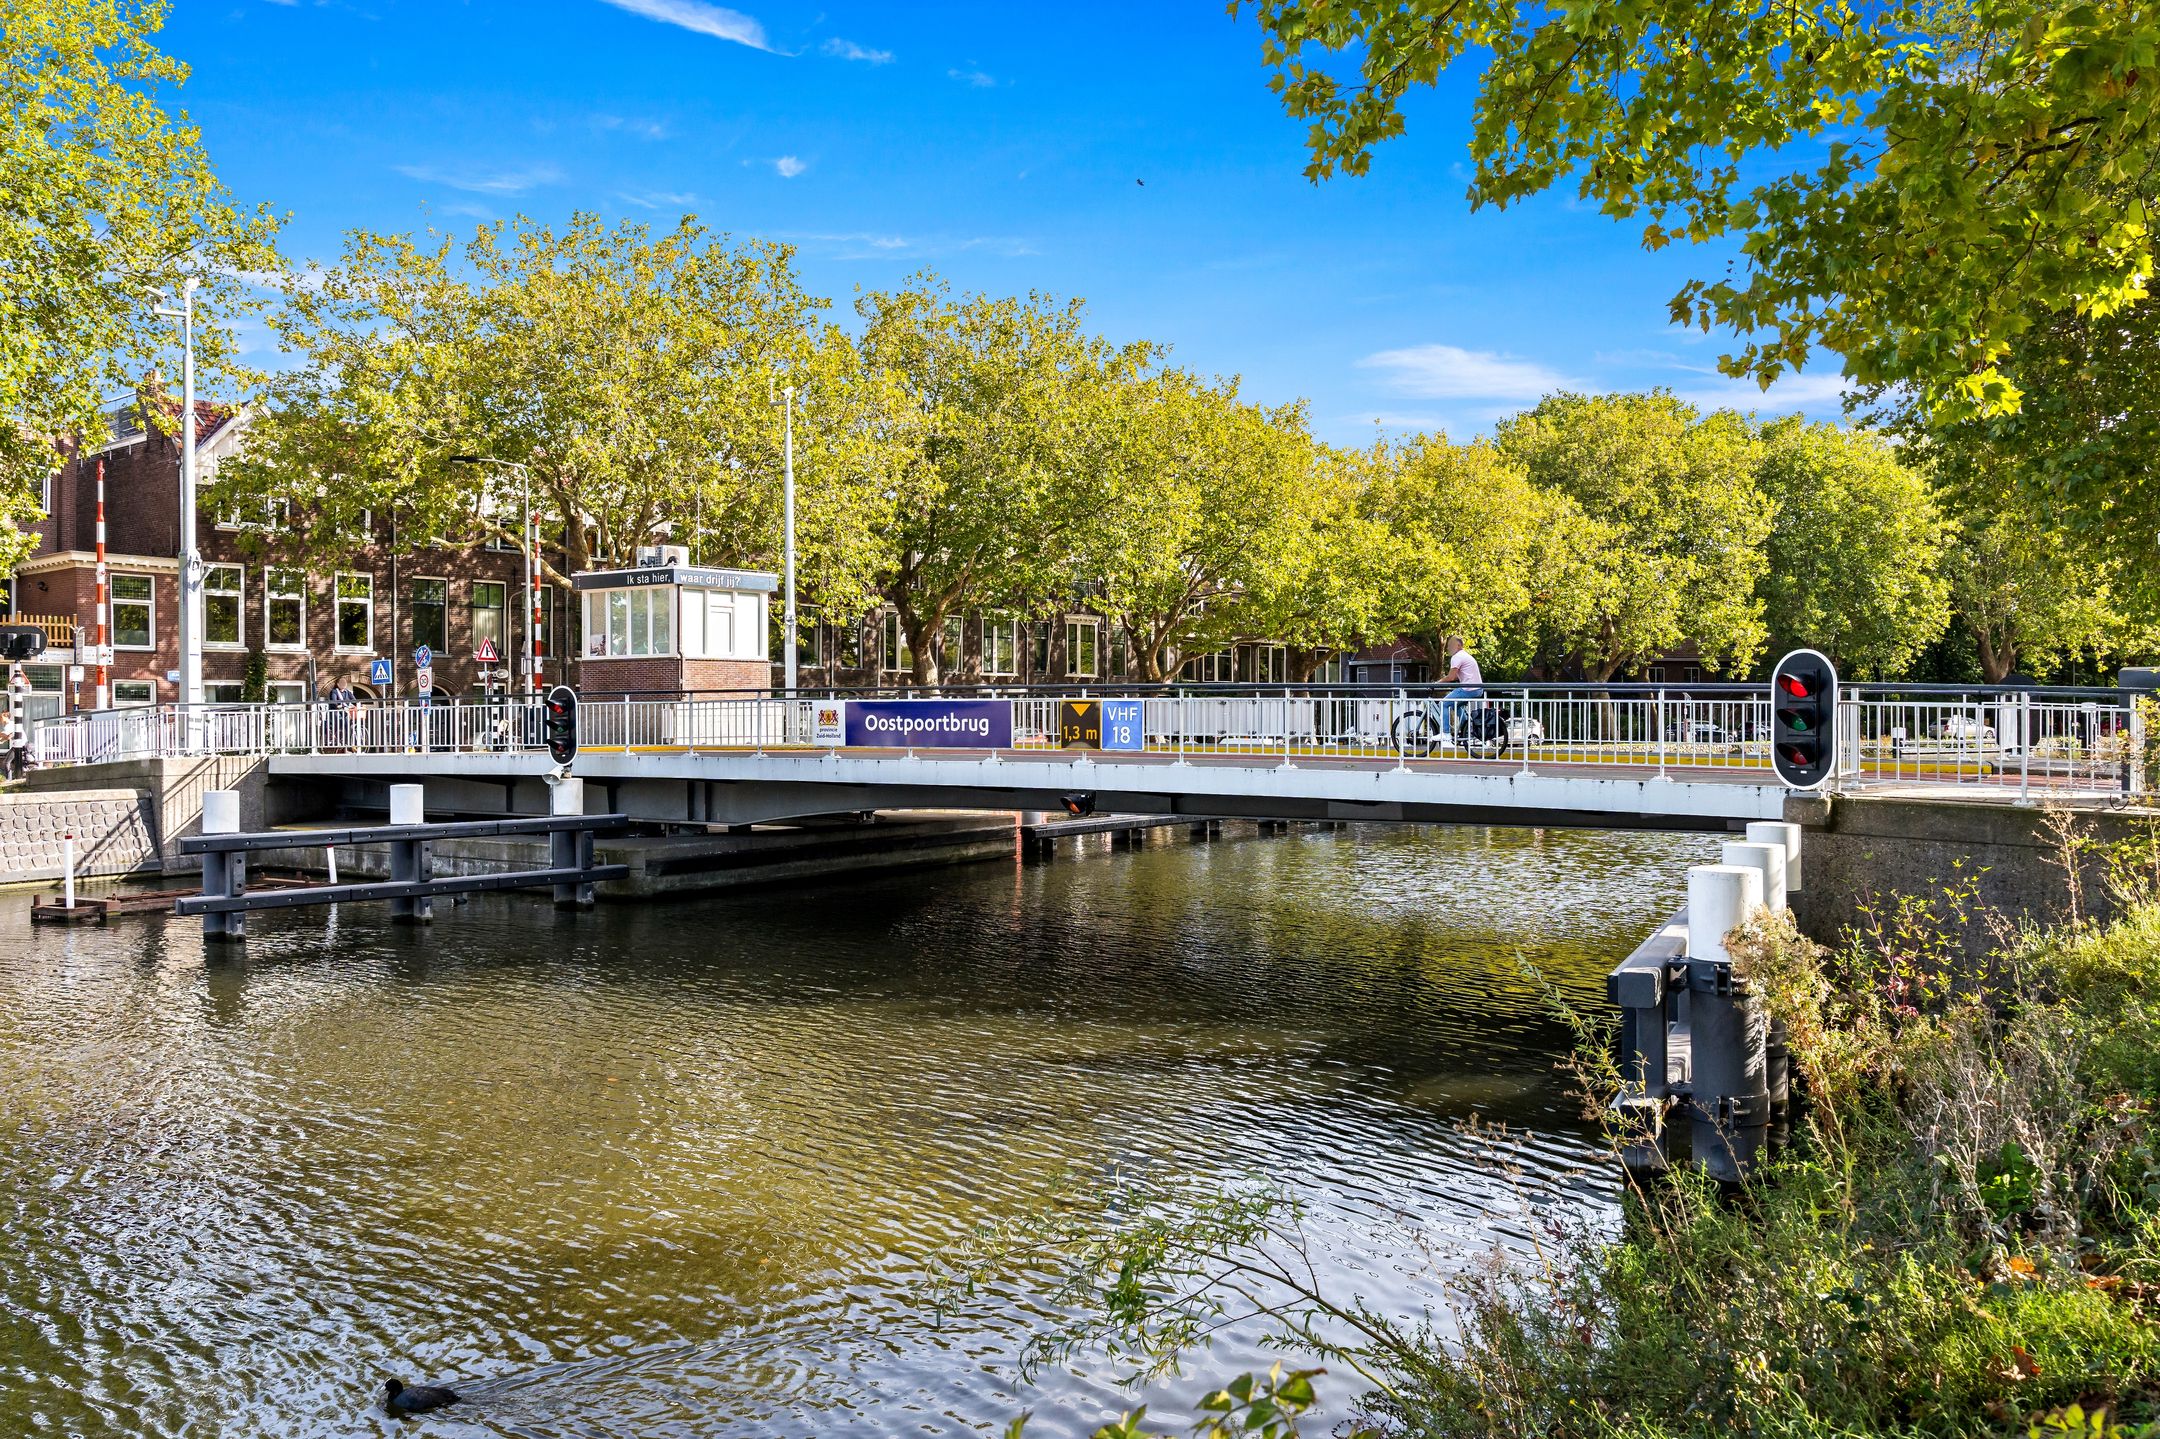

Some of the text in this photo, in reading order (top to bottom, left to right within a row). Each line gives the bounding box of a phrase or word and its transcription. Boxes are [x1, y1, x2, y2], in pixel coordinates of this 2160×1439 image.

[626, 574, 635, 585] Ik
[636, 574, 650, 584] sta
[679, 574, 741, 588] waar drijf jij?
[1107, 706, 1138, 721] VHF
[865, 712, 989, 736] Oostpoortbrug
[1063, 725, 1097, 742] 1,3 m
[1112, 726, 1131, 744] 18
